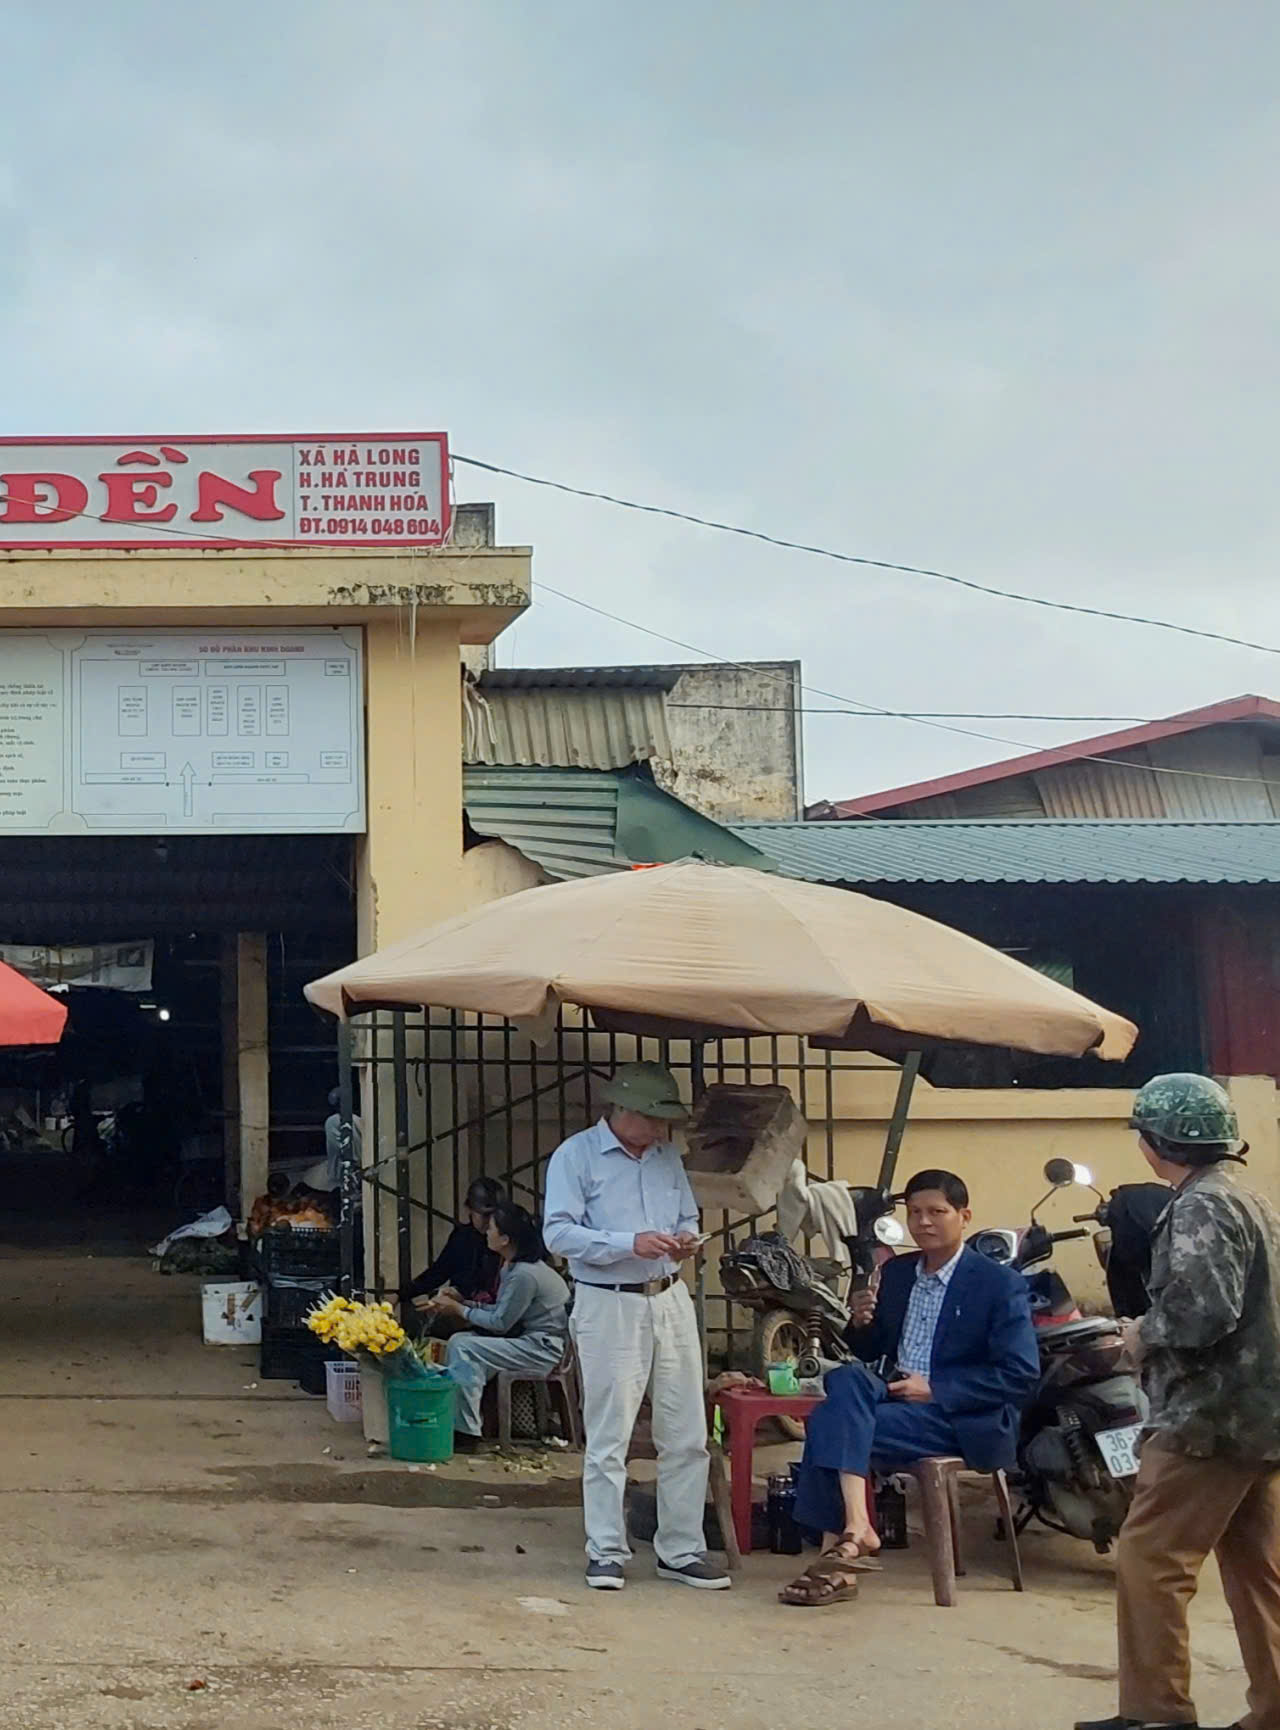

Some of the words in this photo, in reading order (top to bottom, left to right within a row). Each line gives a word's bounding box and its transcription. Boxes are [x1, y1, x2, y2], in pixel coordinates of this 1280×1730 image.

[299, 445, 326, 466] XÃ
[333, 444, 360, 466] HÀ
[367, 449, 420, 466] LONG
[353, 471, 420, 488] TRUNG
[322, 495, 385, 512] THANH
[372, 519, 404, 535] 048
[407, 519, 440, 535] 604
